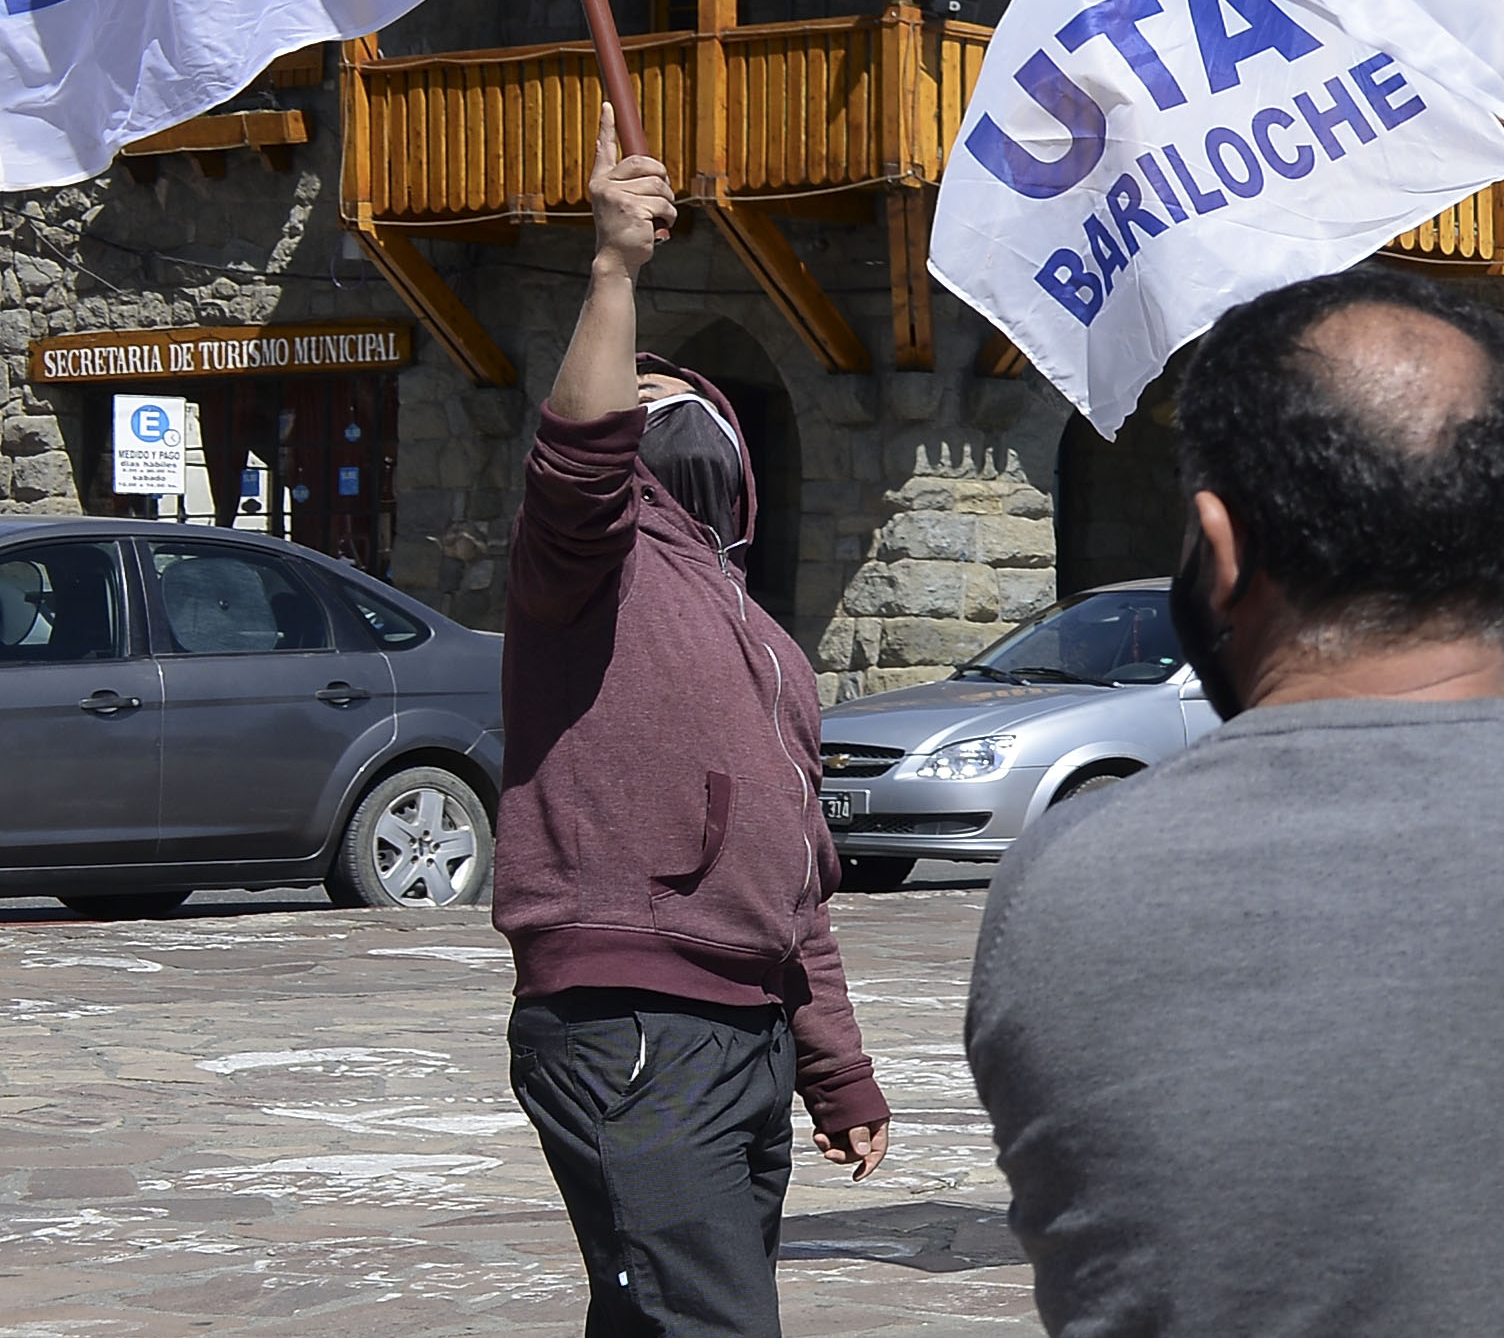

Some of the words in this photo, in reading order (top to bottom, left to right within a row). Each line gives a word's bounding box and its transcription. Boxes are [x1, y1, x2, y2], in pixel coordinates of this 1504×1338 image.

[1033, 52, 1426, 328] BARILOCHE
[44, 346, 165, 378] SECRETARIA
[168, 344, 194, 372] DE
[197, 338, 290, 370] TURISMO
[294, 332, 400, 365] MUNICIPAL
[140, 411, 161, 436] E
[159, 451, 180, 461] PAGO
